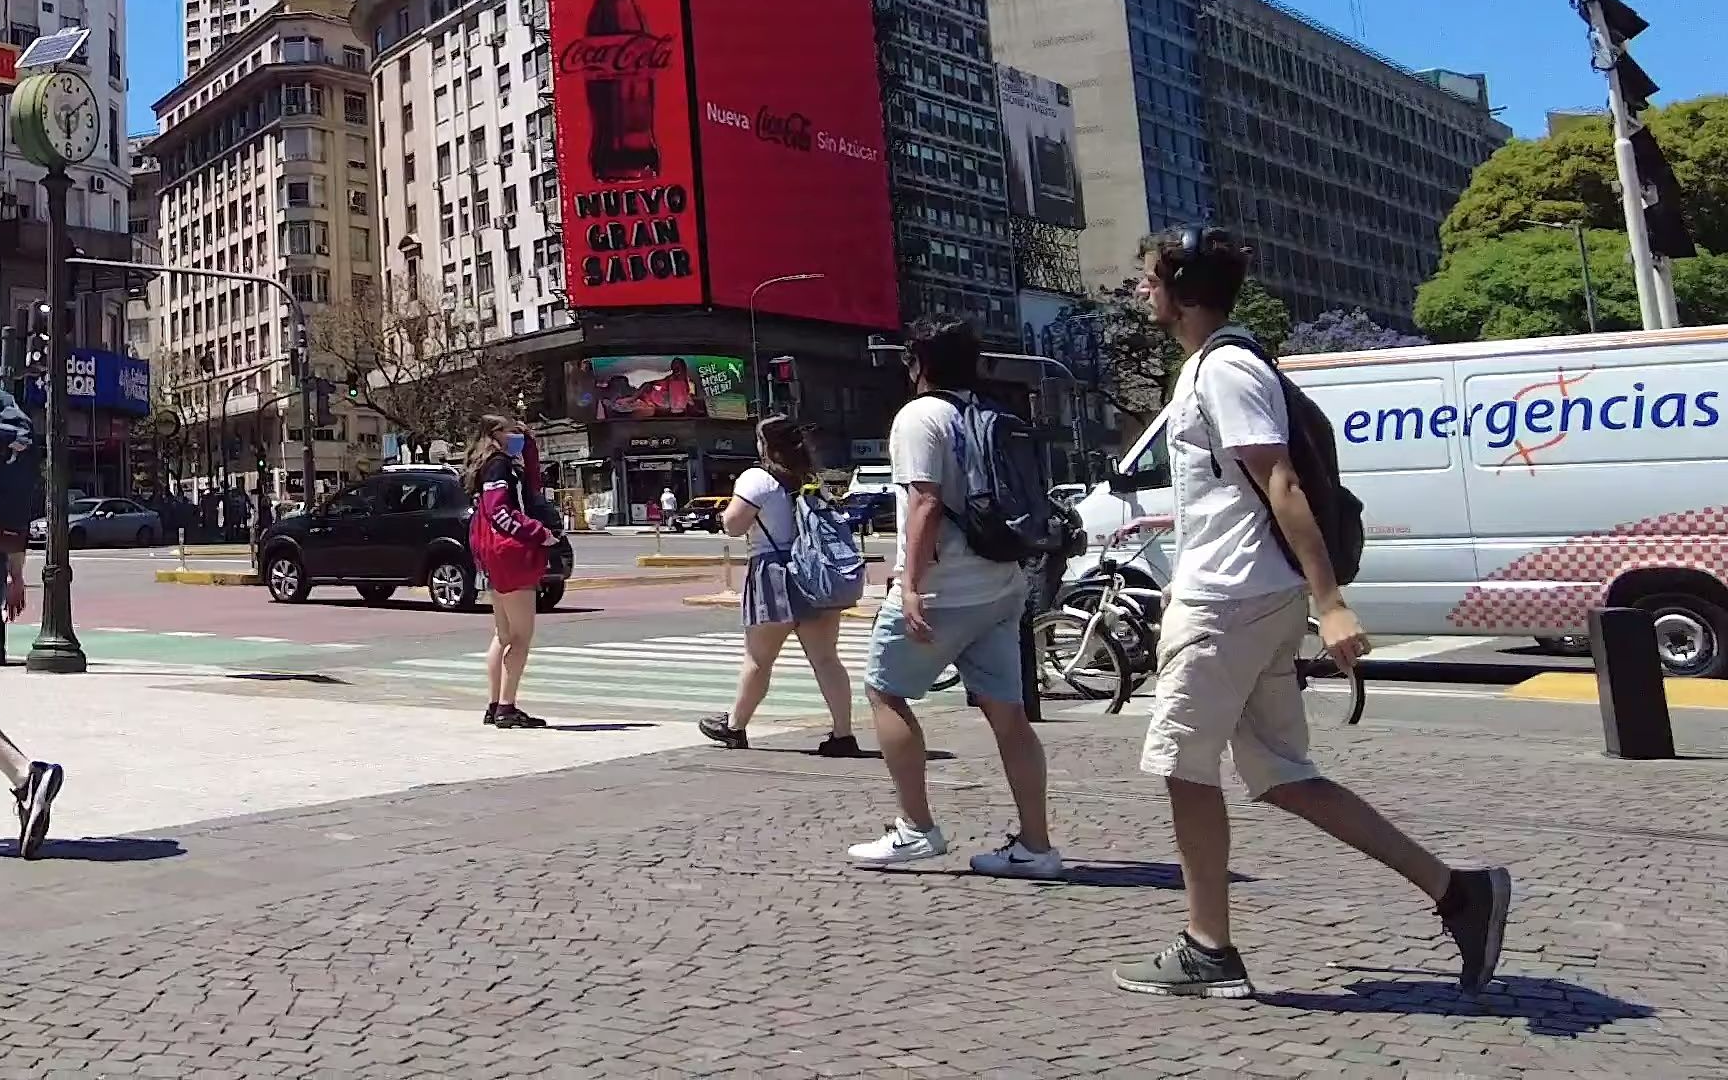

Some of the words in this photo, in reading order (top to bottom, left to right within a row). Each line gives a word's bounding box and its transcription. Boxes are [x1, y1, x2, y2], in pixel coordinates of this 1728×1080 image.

[60, 77, 73, 94] 12
[86, 112, 94, 129] 3
[706, 101, 751, 130] Nueva
[817, 130, 837, 153] Sin
[838, 136, 879, 163] Azúcar
[65, 141, 72, 159] 6
[574, 184, 687, 219] NUEVO
[586, 216, 680, 251] GRAN
[582, 248, 692, 287] SABOR
[1342, 381, 1721, 449] emergencias
